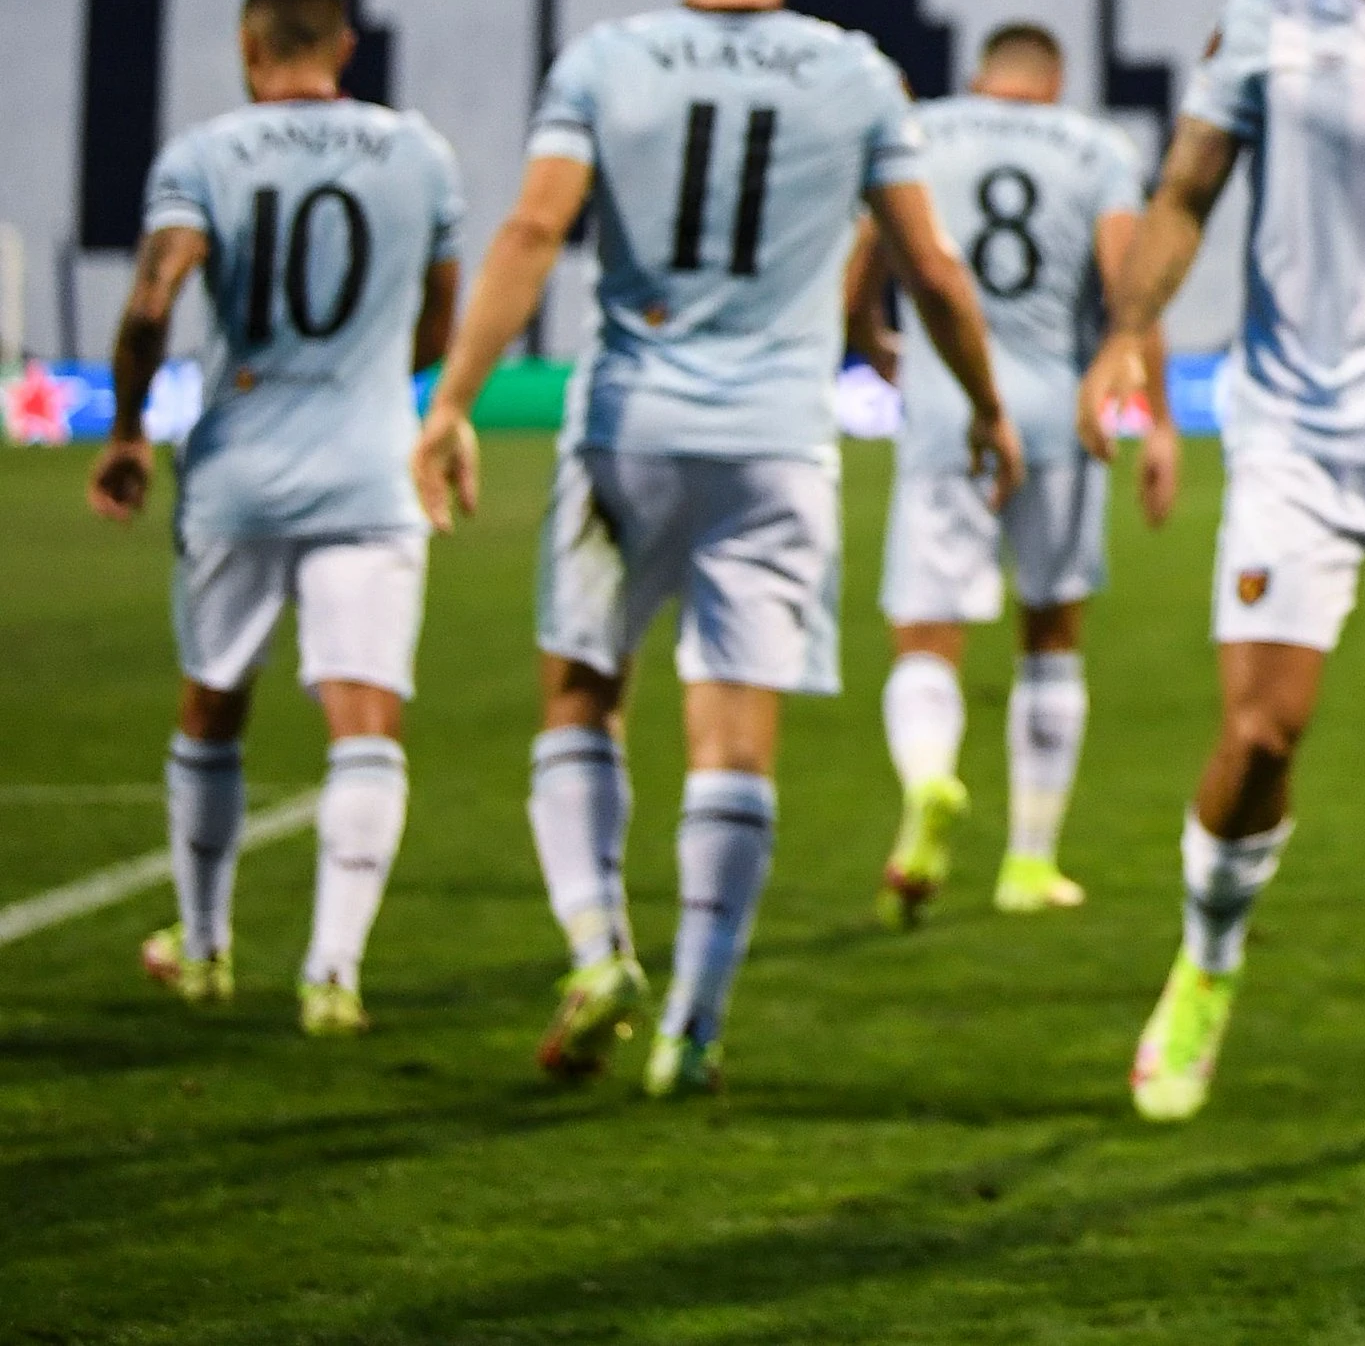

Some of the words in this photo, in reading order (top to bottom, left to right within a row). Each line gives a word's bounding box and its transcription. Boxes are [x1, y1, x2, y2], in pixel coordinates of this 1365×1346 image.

[247, 180, 372, 344] 10
[669, 100, 777, 278] 11
[971, 166, 1041, 300] 8
